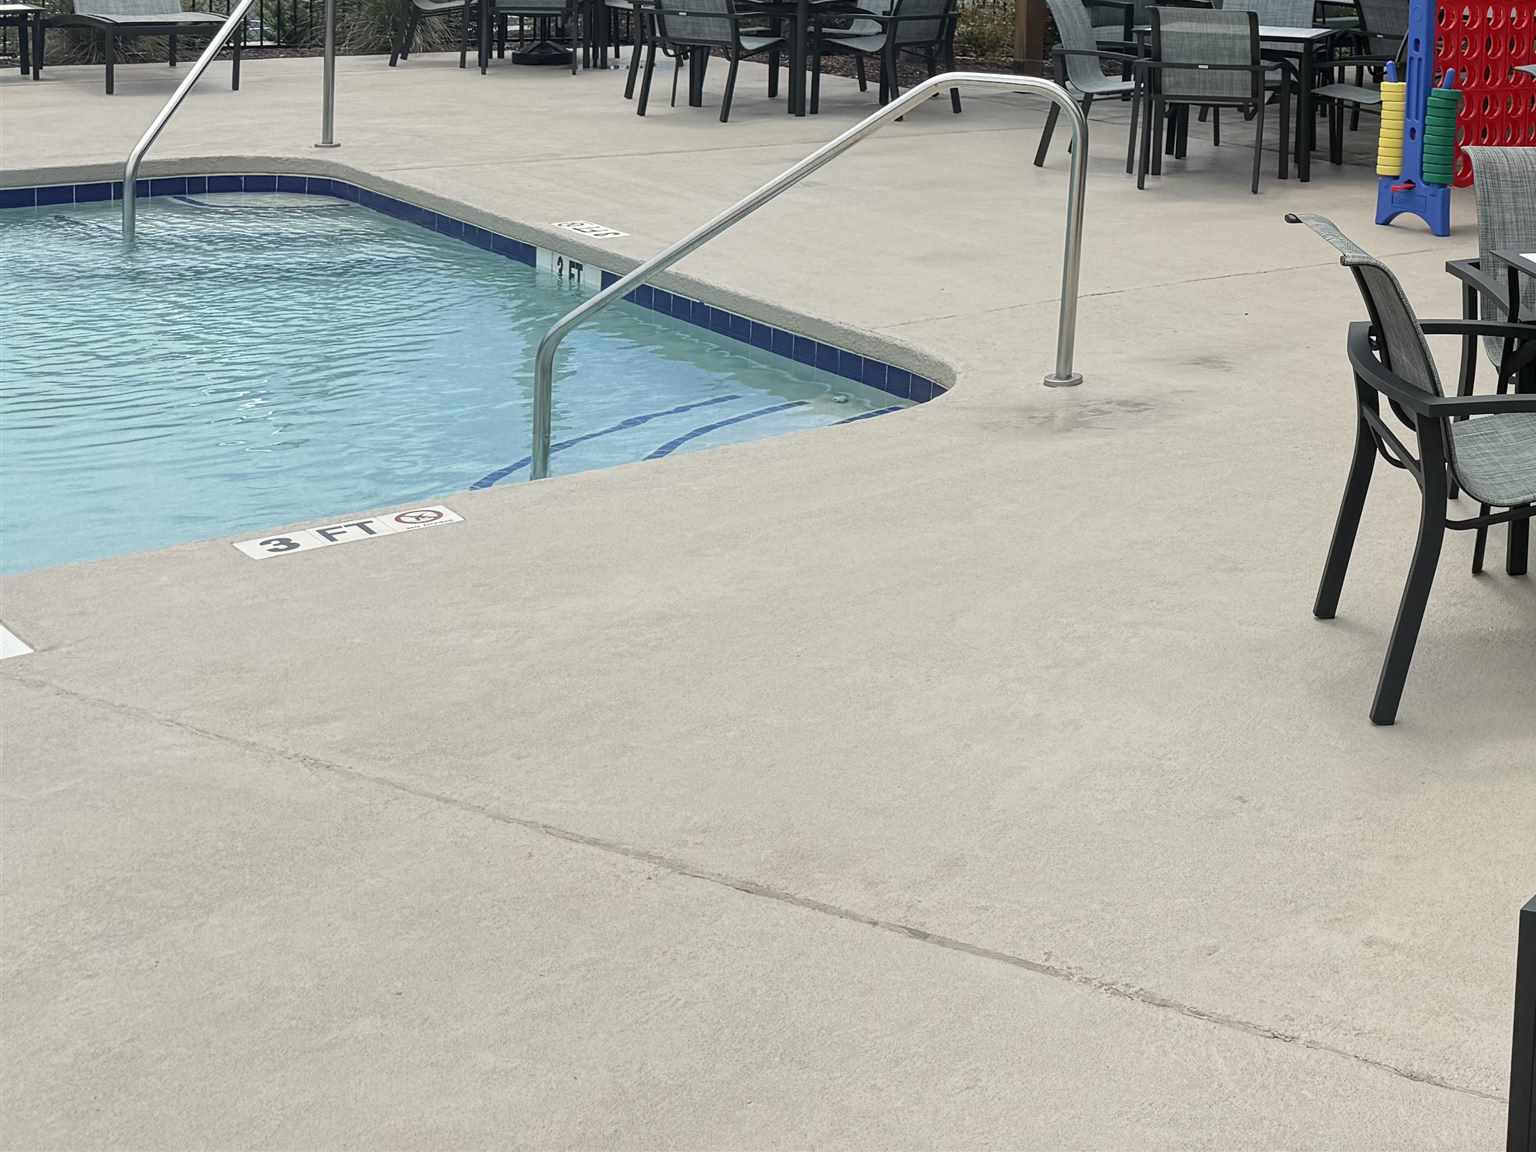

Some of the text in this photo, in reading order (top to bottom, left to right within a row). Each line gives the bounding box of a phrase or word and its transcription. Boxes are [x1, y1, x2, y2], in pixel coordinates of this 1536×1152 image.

[569, 259, 584, 283] FT
[259, 520, 377, 553] 3 FT
